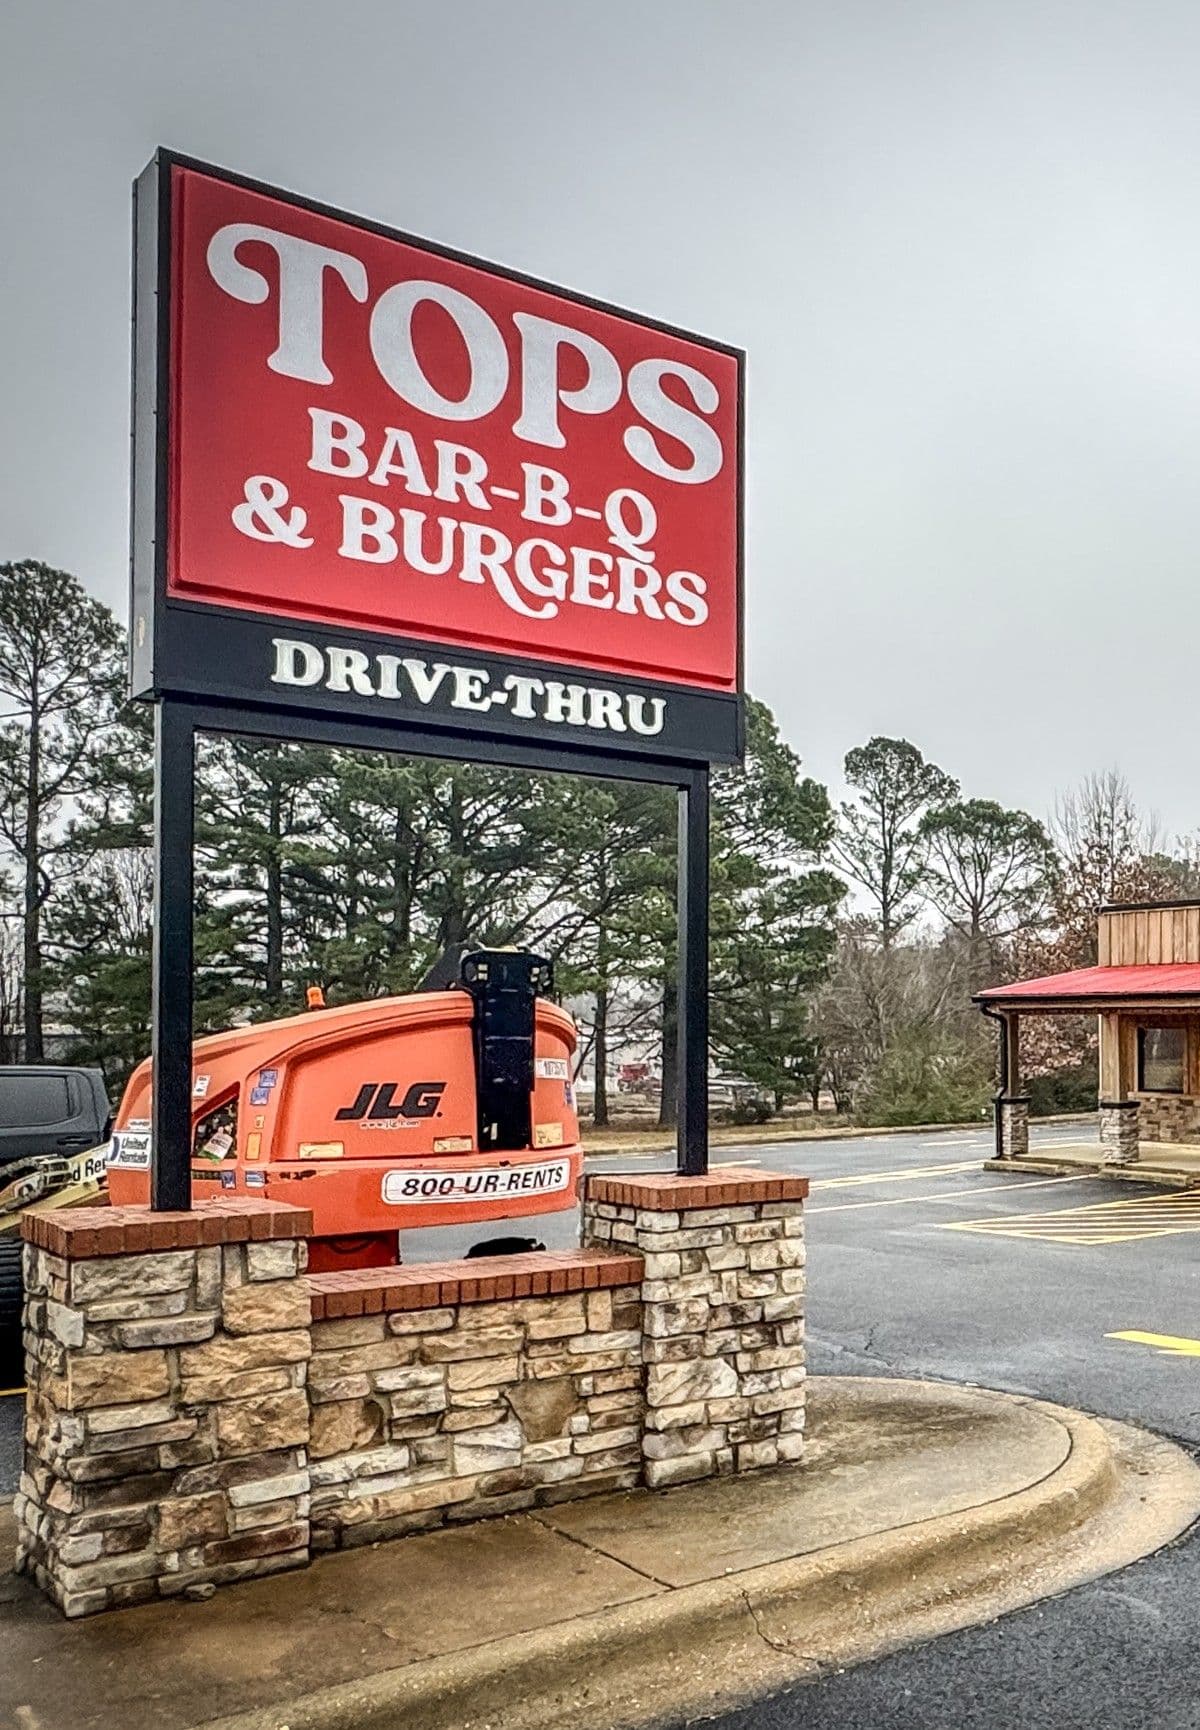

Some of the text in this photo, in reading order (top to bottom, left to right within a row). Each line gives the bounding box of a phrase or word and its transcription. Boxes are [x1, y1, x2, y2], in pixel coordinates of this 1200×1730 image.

[207, 223, 724, 485] TOPS
[231, 475, 709, 627] & BURGERS
[307, 407, 657, 561] BAR-B-Q
[270, 638, 667, 736] DRIVE-THRU
[121, 1136, 149, 1150] United
